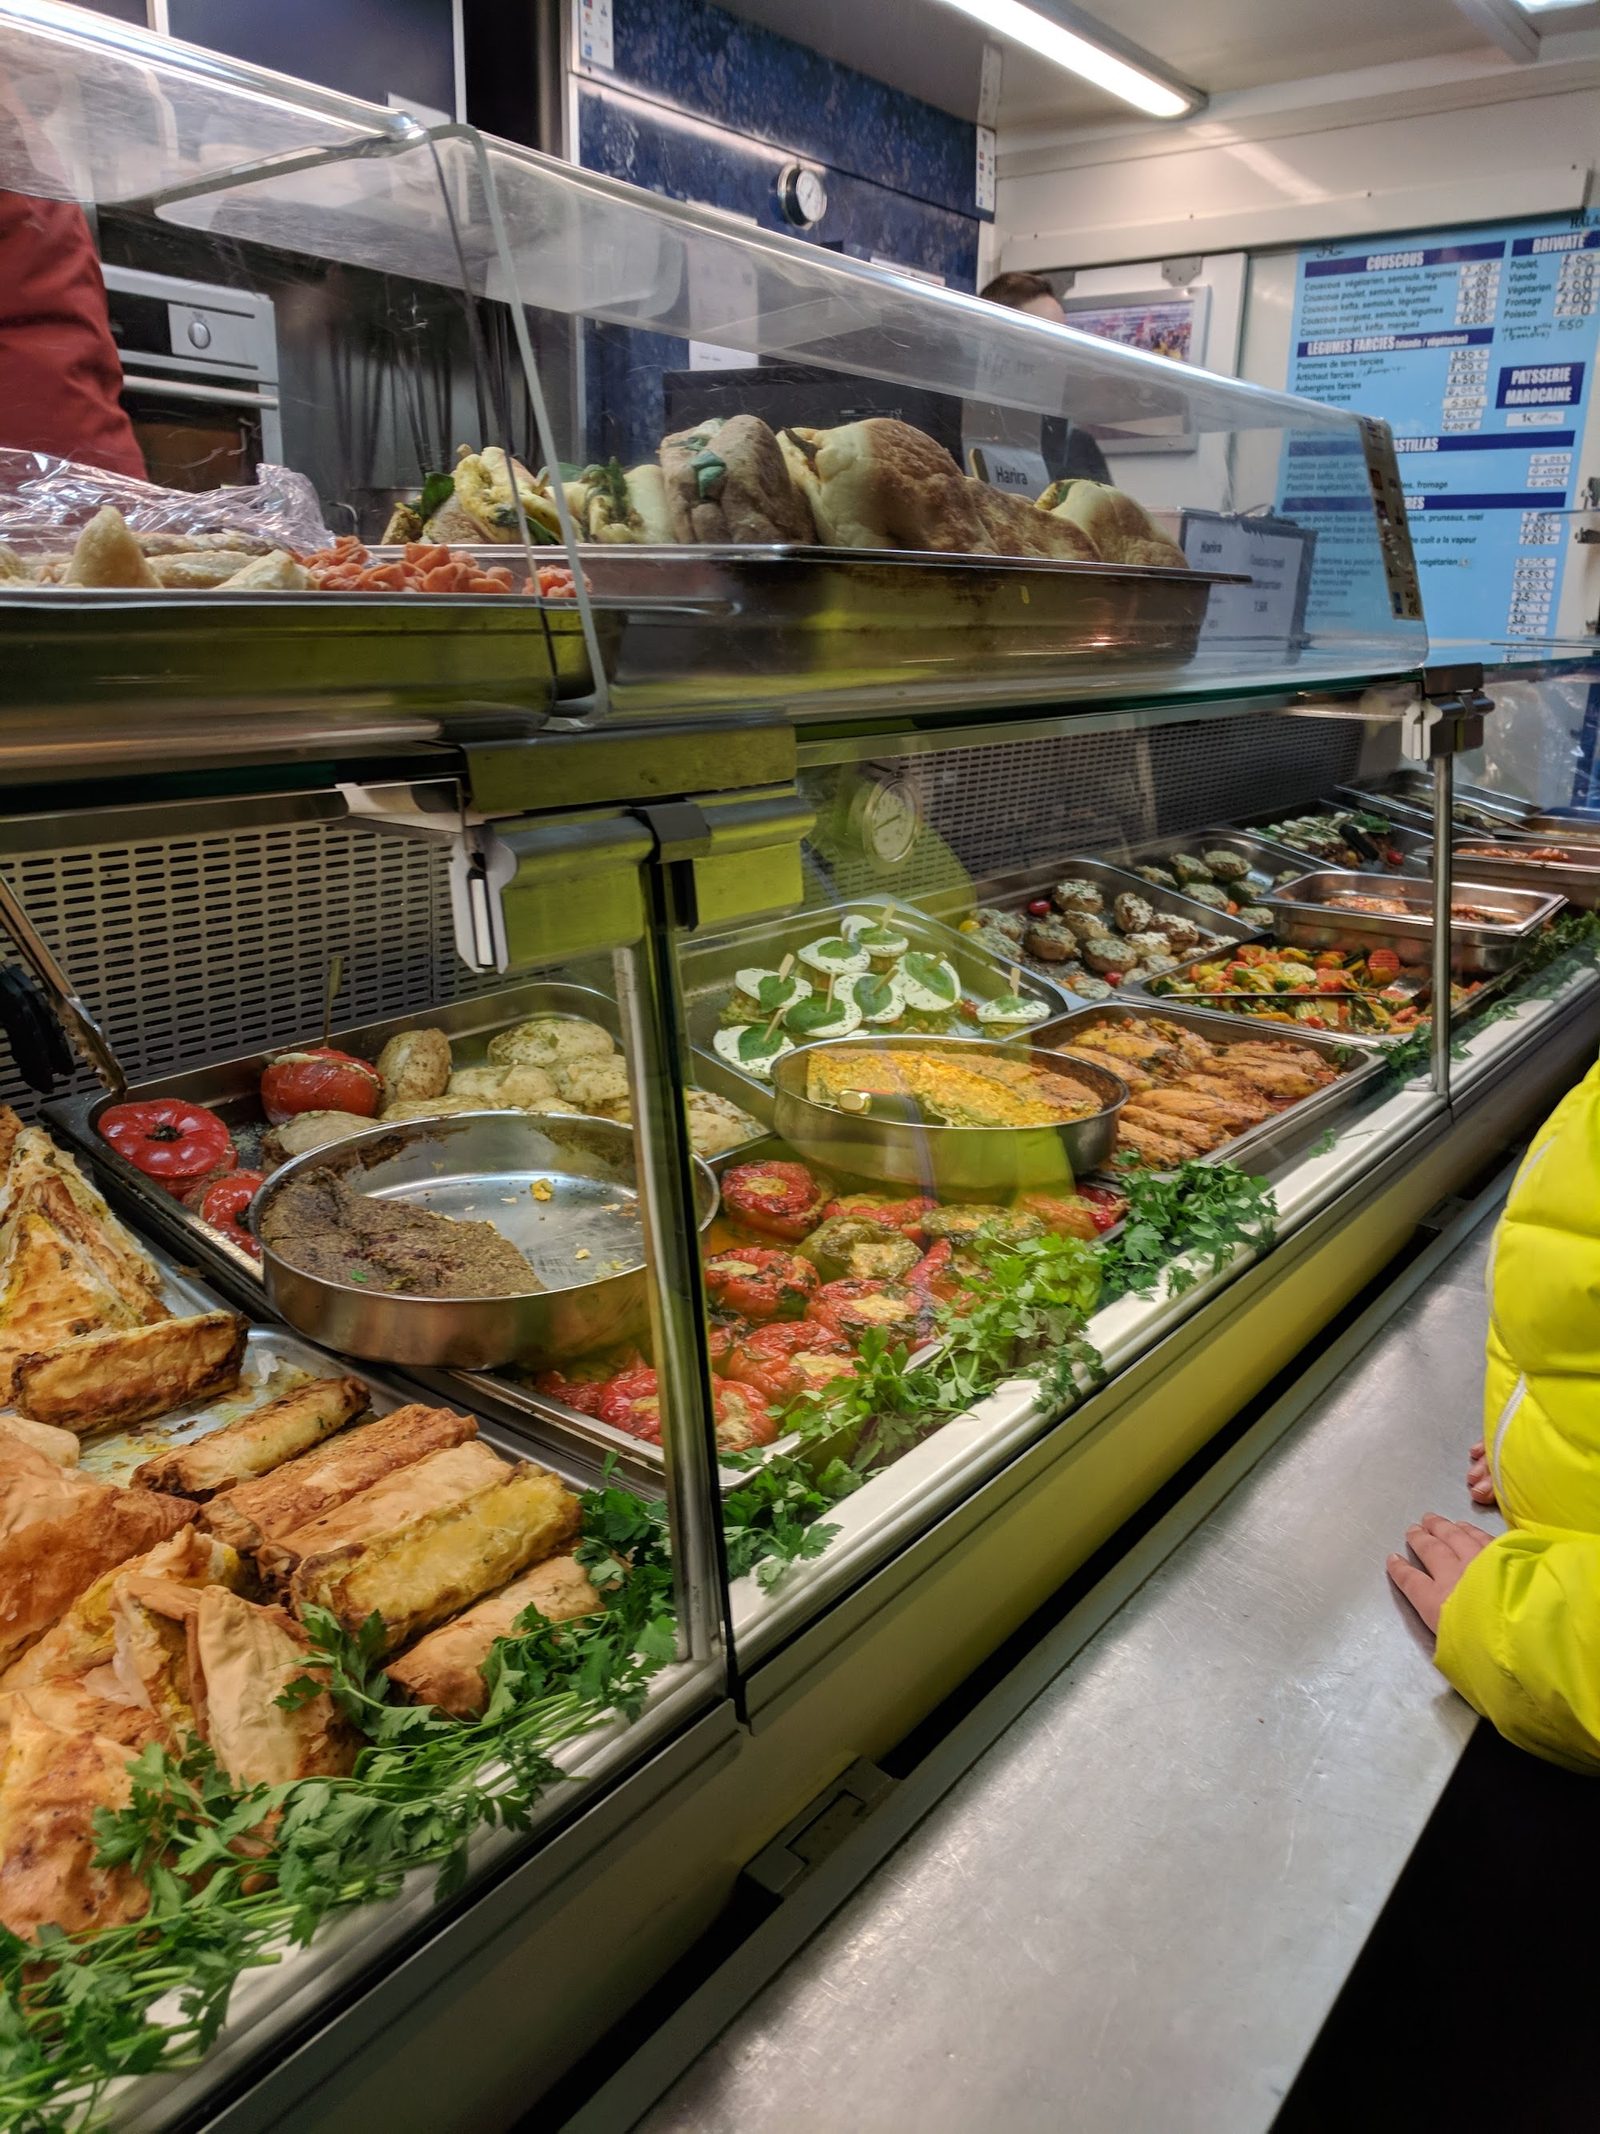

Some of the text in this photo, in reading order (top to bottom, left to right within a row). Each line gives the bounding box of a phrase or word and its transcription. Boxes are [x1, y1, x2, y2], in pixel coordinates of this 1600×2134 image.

[1366, 251, 1424, 272] COUSCOUS
[1509, 272, 1537, 283] Viande
[1304, 281, 1341, 292] Couscous
[1303, 293, 1339, 303] Couscous
[1505, 296, 1543, 309] Fromage
[1302, 304, 1338, 315] Couscous
[1503, 309, 1537, 320] Poisson
[1301, 316, 1337, 326] Couscous
[1300, 327, 1336, 337] Couscous
[1353, 336, 1396, 353] FARCIES
[1297, 357, 1385, 371] Pommes de terre farcies
[1297, 373, 1329, 382] Artichaut
[1330, 371, 1355, 379] farcies
[1511, 366, 1572, 386] PATSSERIE
[1296, 382, 1362, 394] Aubergines farcies
[1327, 394, 1352, 402] farcies
[1505, 386, 1573, 405] MAROCAINE
[995, 467, 1028, 486] Harira
[1417, 481, 1448, 489] fromage
[1451, 537, 1477, 545] vapeur
